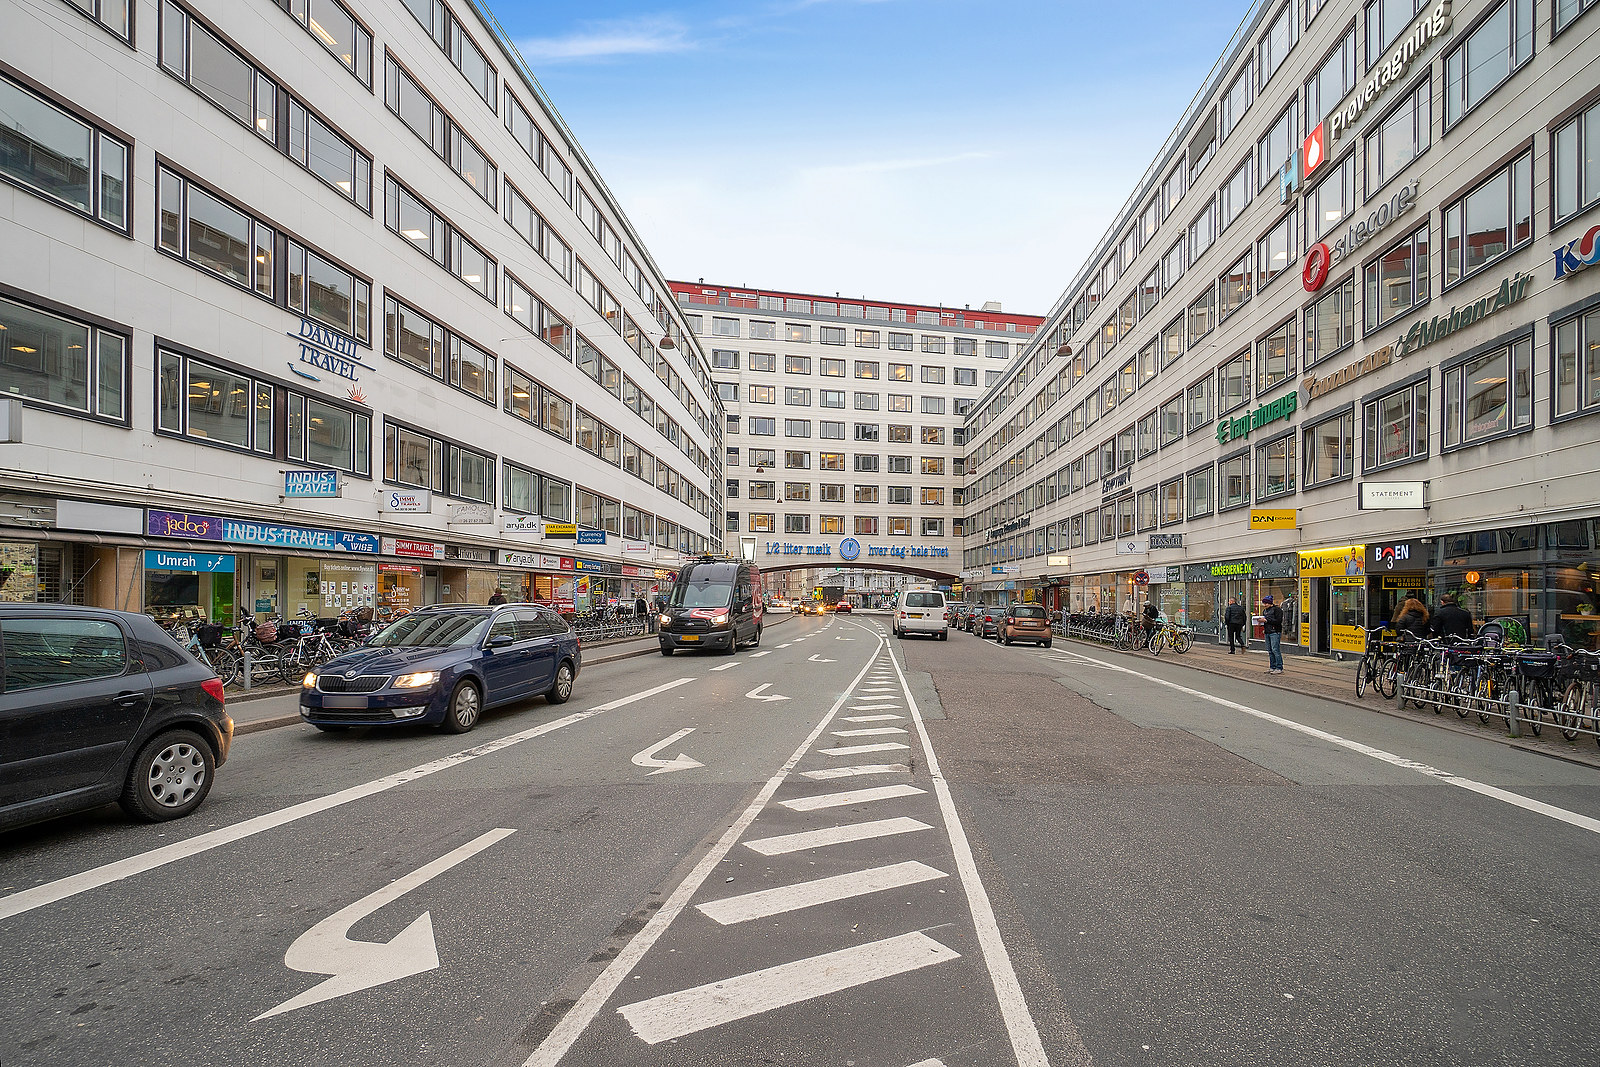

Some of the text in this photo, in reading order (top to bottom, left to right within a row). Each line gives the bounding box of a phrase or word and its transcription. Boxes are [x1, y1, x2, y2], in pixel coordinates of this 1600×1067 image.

[1331, 3, 1448, 140] Prøvetagning
[1334, 184, 1414, 262] sitecore
[1417, 271, 1535, 349] Mahan Air
[299, 318, 362, 360] DANHIL
[298, 342, 359, 382] TRAVEL
[1311, 345, 1391, 398] OMAN AIR
[1251, 390, 1297, 430] airways
[288, 472, 328, 484] INDUS
[287, 483, 335, 494] TRAVEL
[164, 514, 207, 536] jadoo
[505, 521, 537, 531] arya.dk
[228, 523, 332, 547] INDUS TRAVEL
[342, 533, 356, 542] FLY
[396, 541, 413, 551] SIMMY
[413, 543, 434, 553] TRAVELS
[765, 542, 780, 555] 1/2
[783, 542, 804, 555] liter
[806, 543, 831, 555] mælk
[868, 544, 888, 556] hver
[890, 544, 906, 559] dag
[910, 545, 928, 557] hele
[930, 545, 949, 557] livet
[157, 554, 196, 567] Umrah
[513, 553, 535, 566] arya.dk
[1301, 556, 1322, 570] DAN
[1387, 556, 1393, 570] 3
